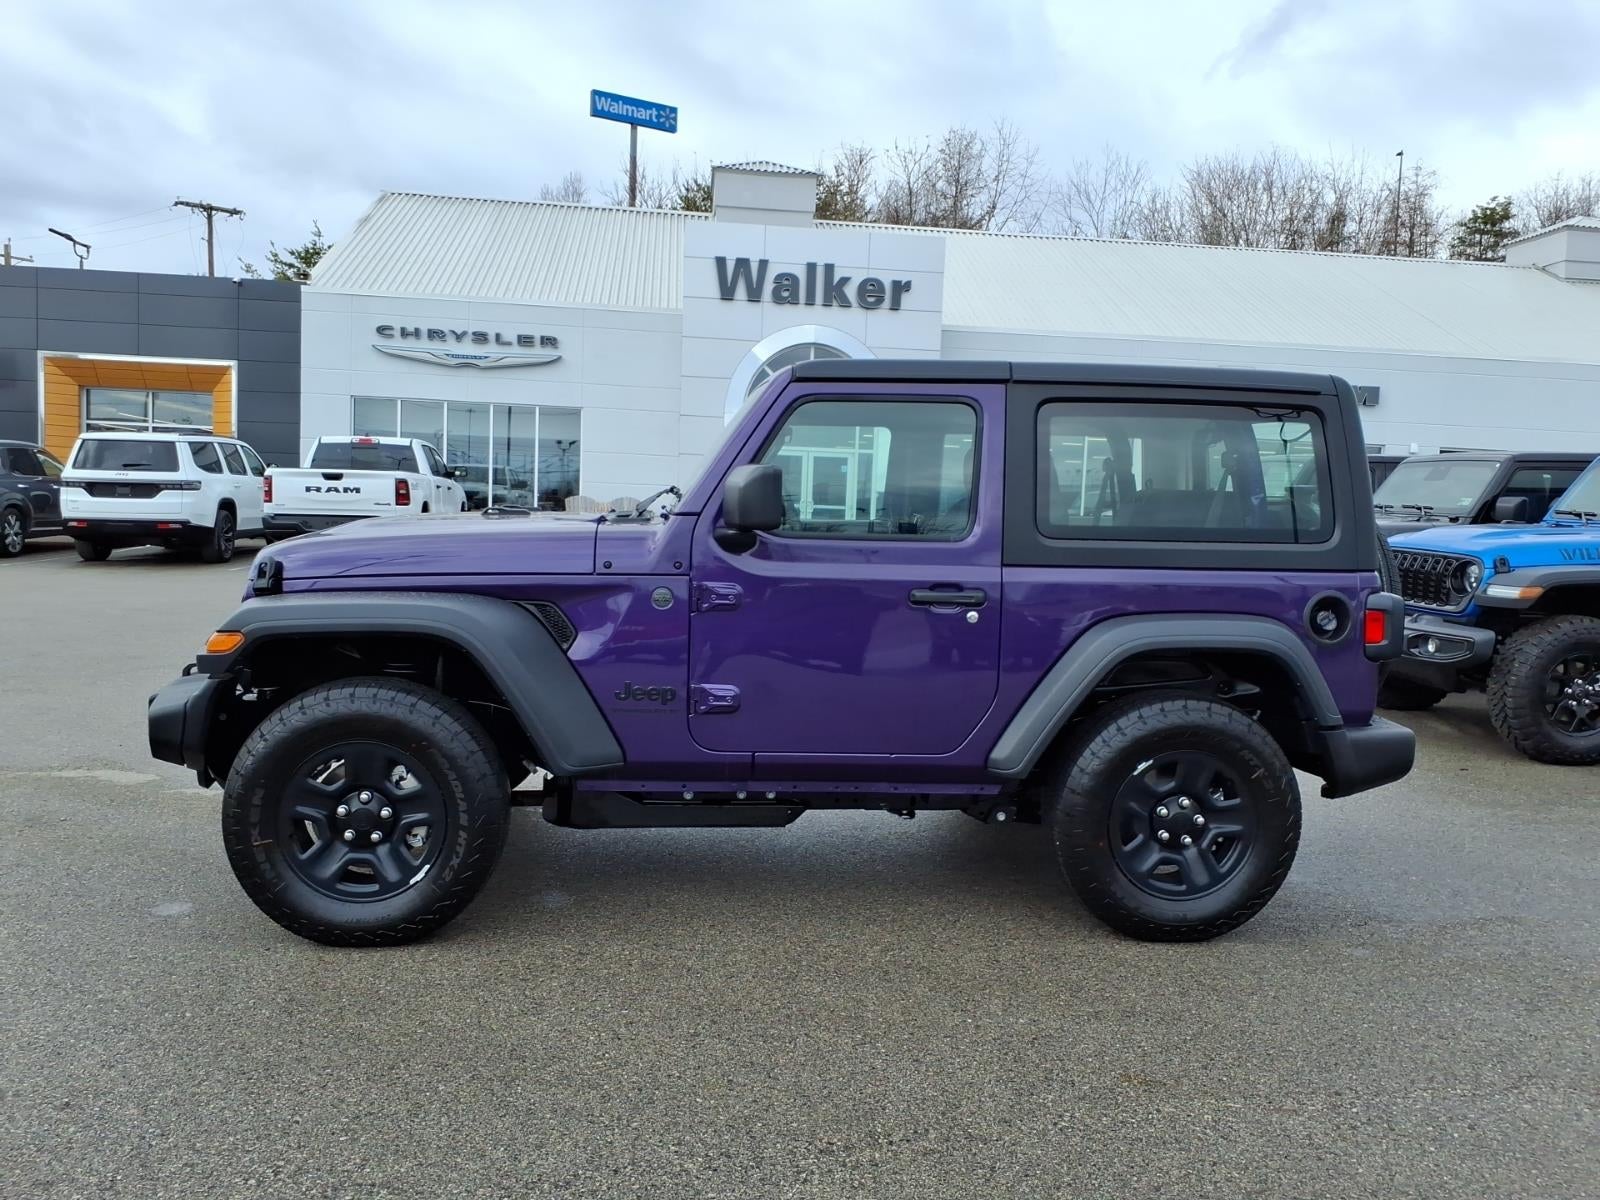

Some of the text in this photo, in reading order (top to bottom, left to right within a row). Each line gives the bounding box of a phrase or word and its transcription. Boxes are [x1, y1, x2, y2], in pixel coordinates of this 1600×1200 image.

[594, 95, 658, 122] Walmart
[714, 255, 912, 310] Walker
[375, 324, 559, 348] CHRYSLER
[305, 486, 361, 494] RAM
[614, 680, 677, 706] Jeep
